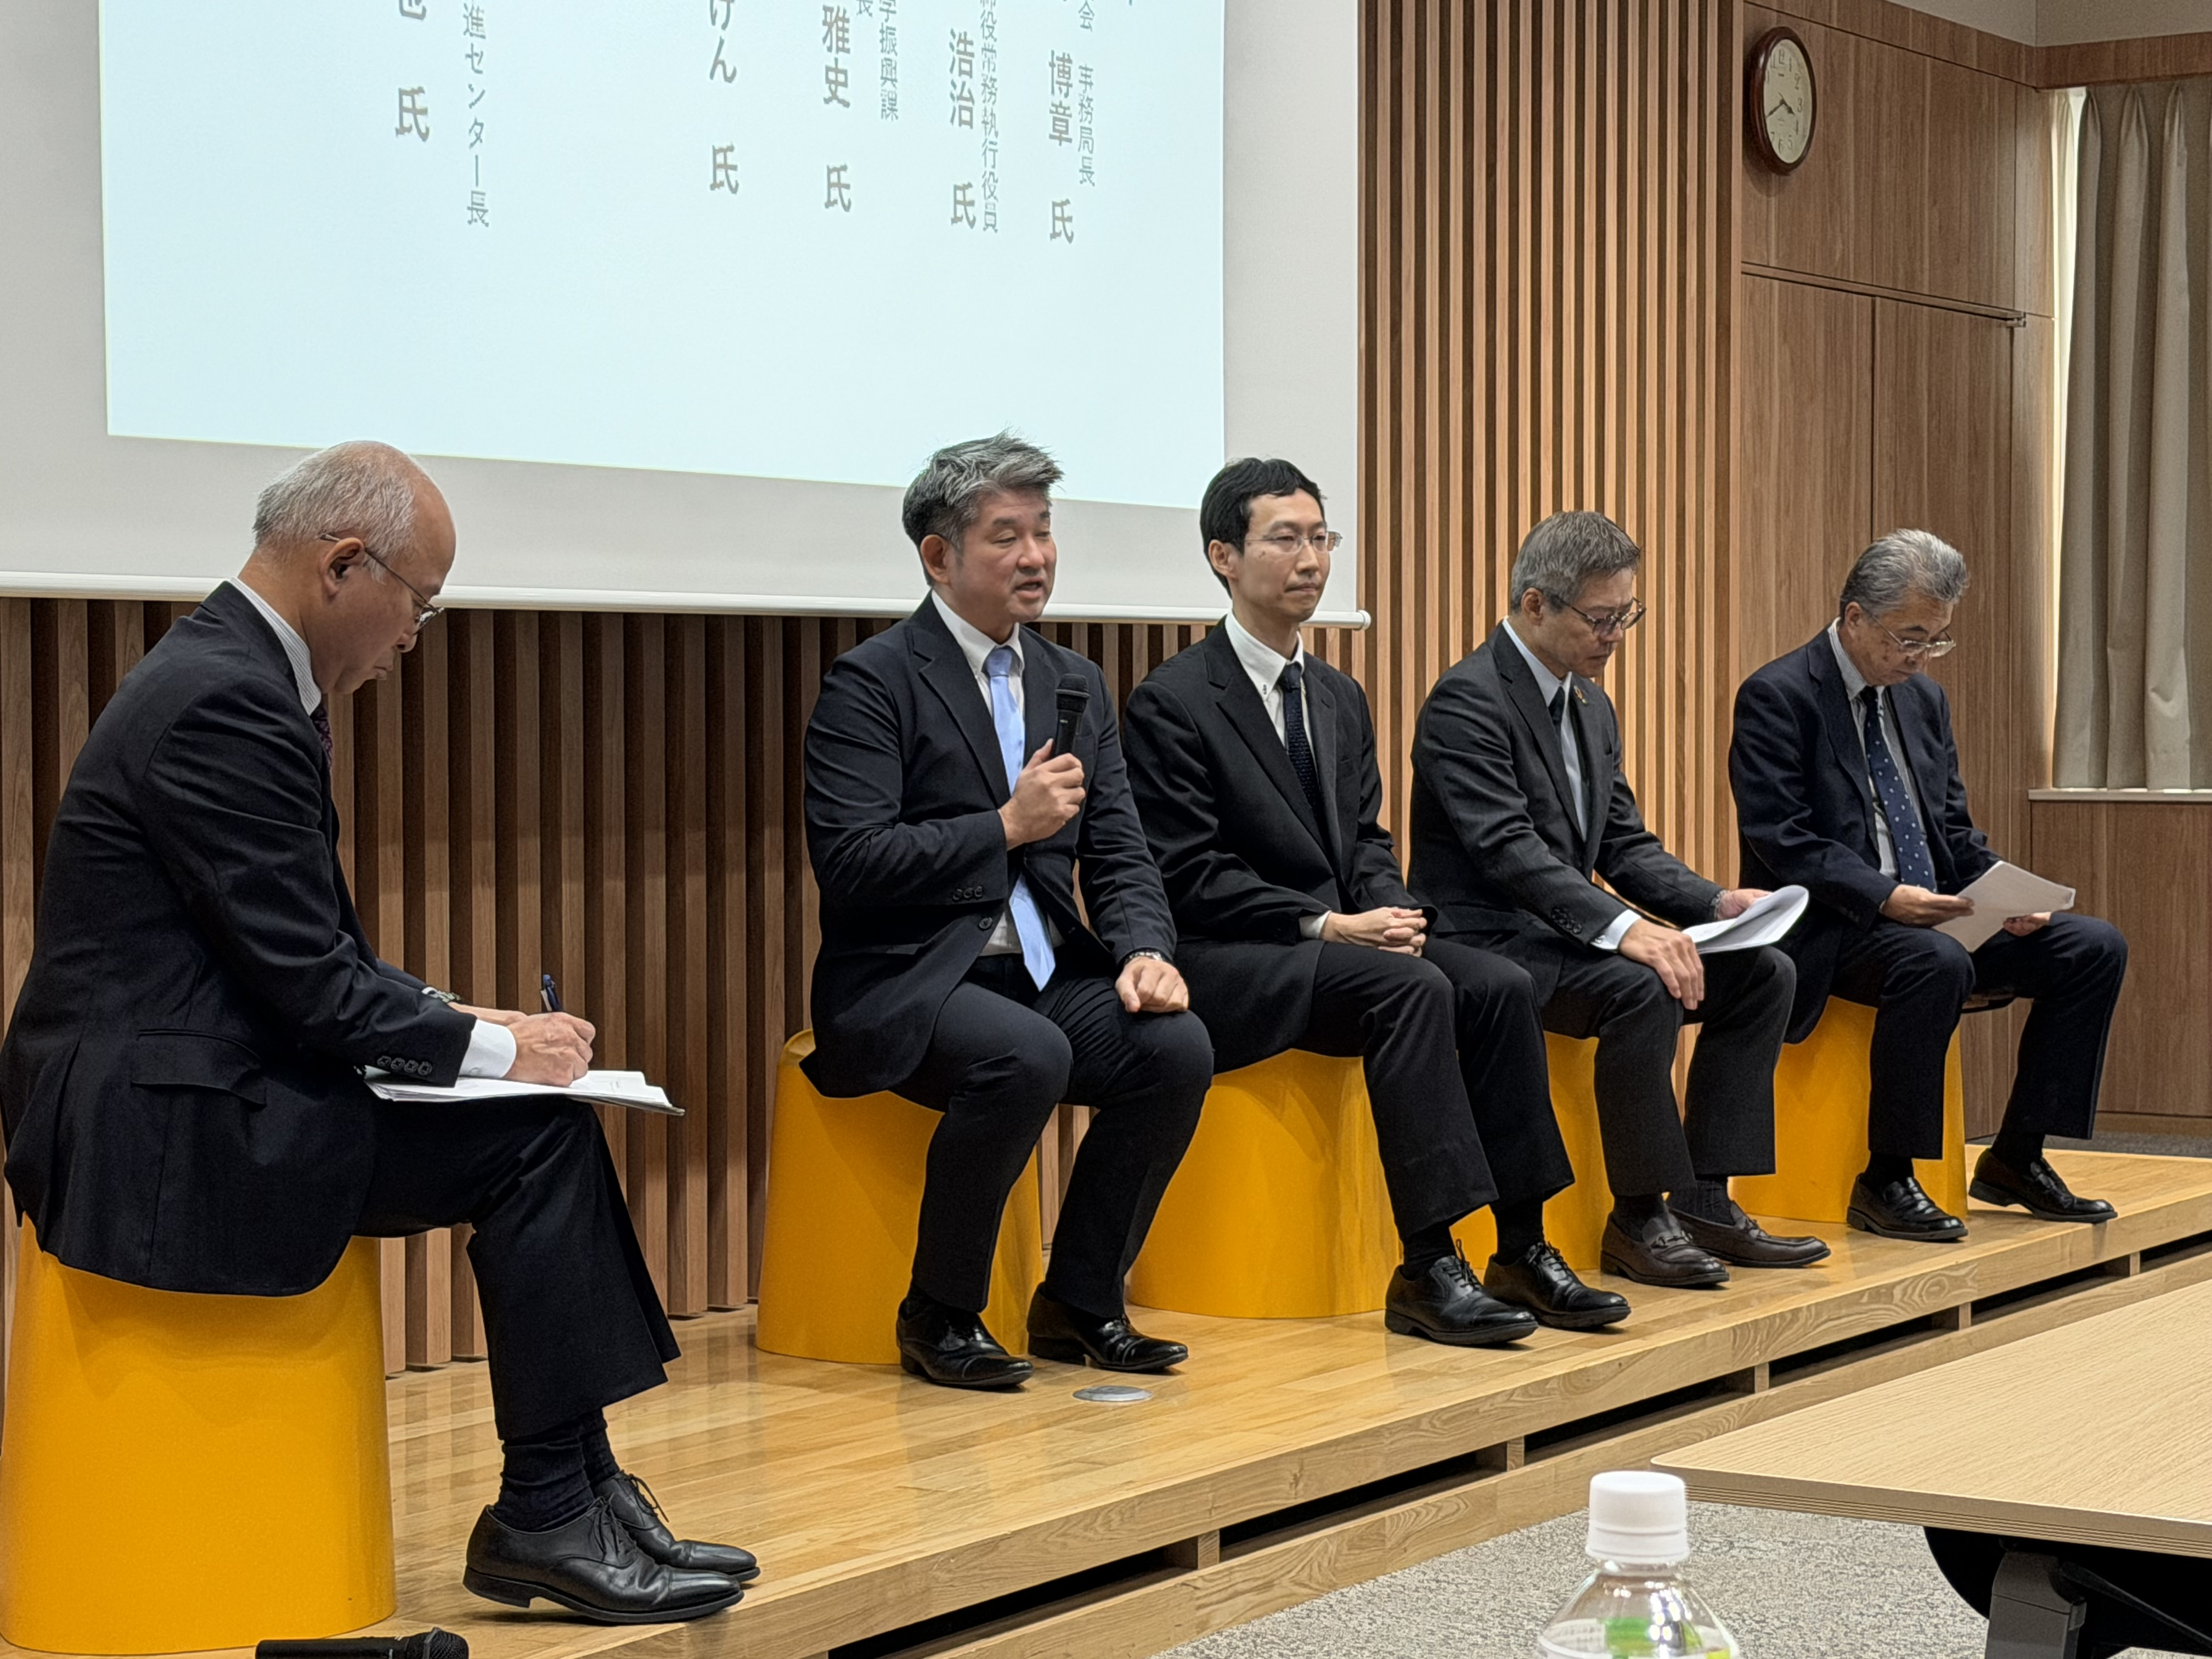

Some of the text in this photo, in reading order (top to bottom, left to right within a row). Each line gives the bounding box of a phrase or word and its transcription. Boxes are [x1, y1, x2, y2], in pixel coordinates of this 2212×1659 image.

[395, 86, 430, 142] 氏
[463, 1, 489, 227] 進センター長
[710, 144, 739, 194] 氏
[822, 5, 851, 212] 雅史 氏
[949, 29, 976, 229] 浩治 氏
[1049, 50, 1074, 244] 博章 氏
[1078, 64, 1095, 187] 事務局長
